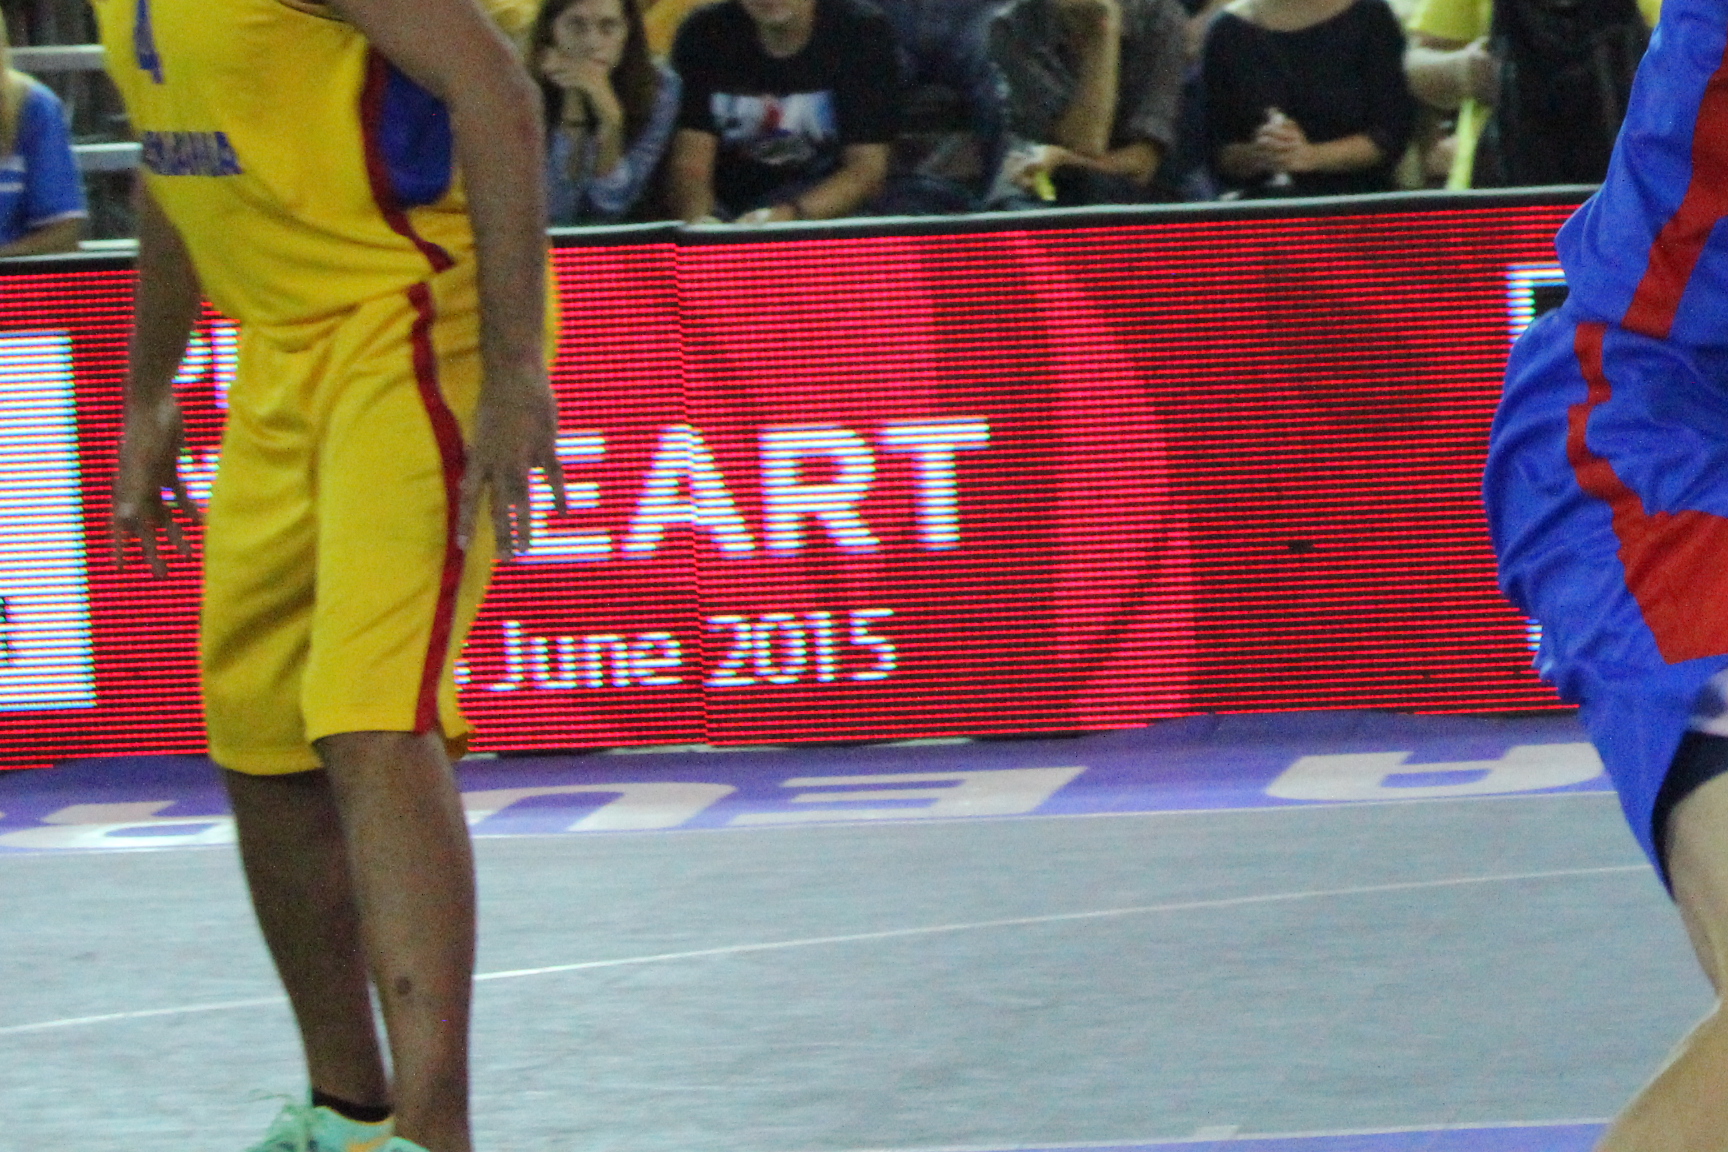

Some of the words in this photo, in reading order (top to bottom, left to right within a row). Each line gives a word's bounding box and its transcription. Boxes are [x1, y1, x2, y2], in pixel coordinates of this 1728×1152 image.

[514, 416, 990, 564] EART
[485, 618, 683, 692] June
[703, 607, 896, 687] 2015
